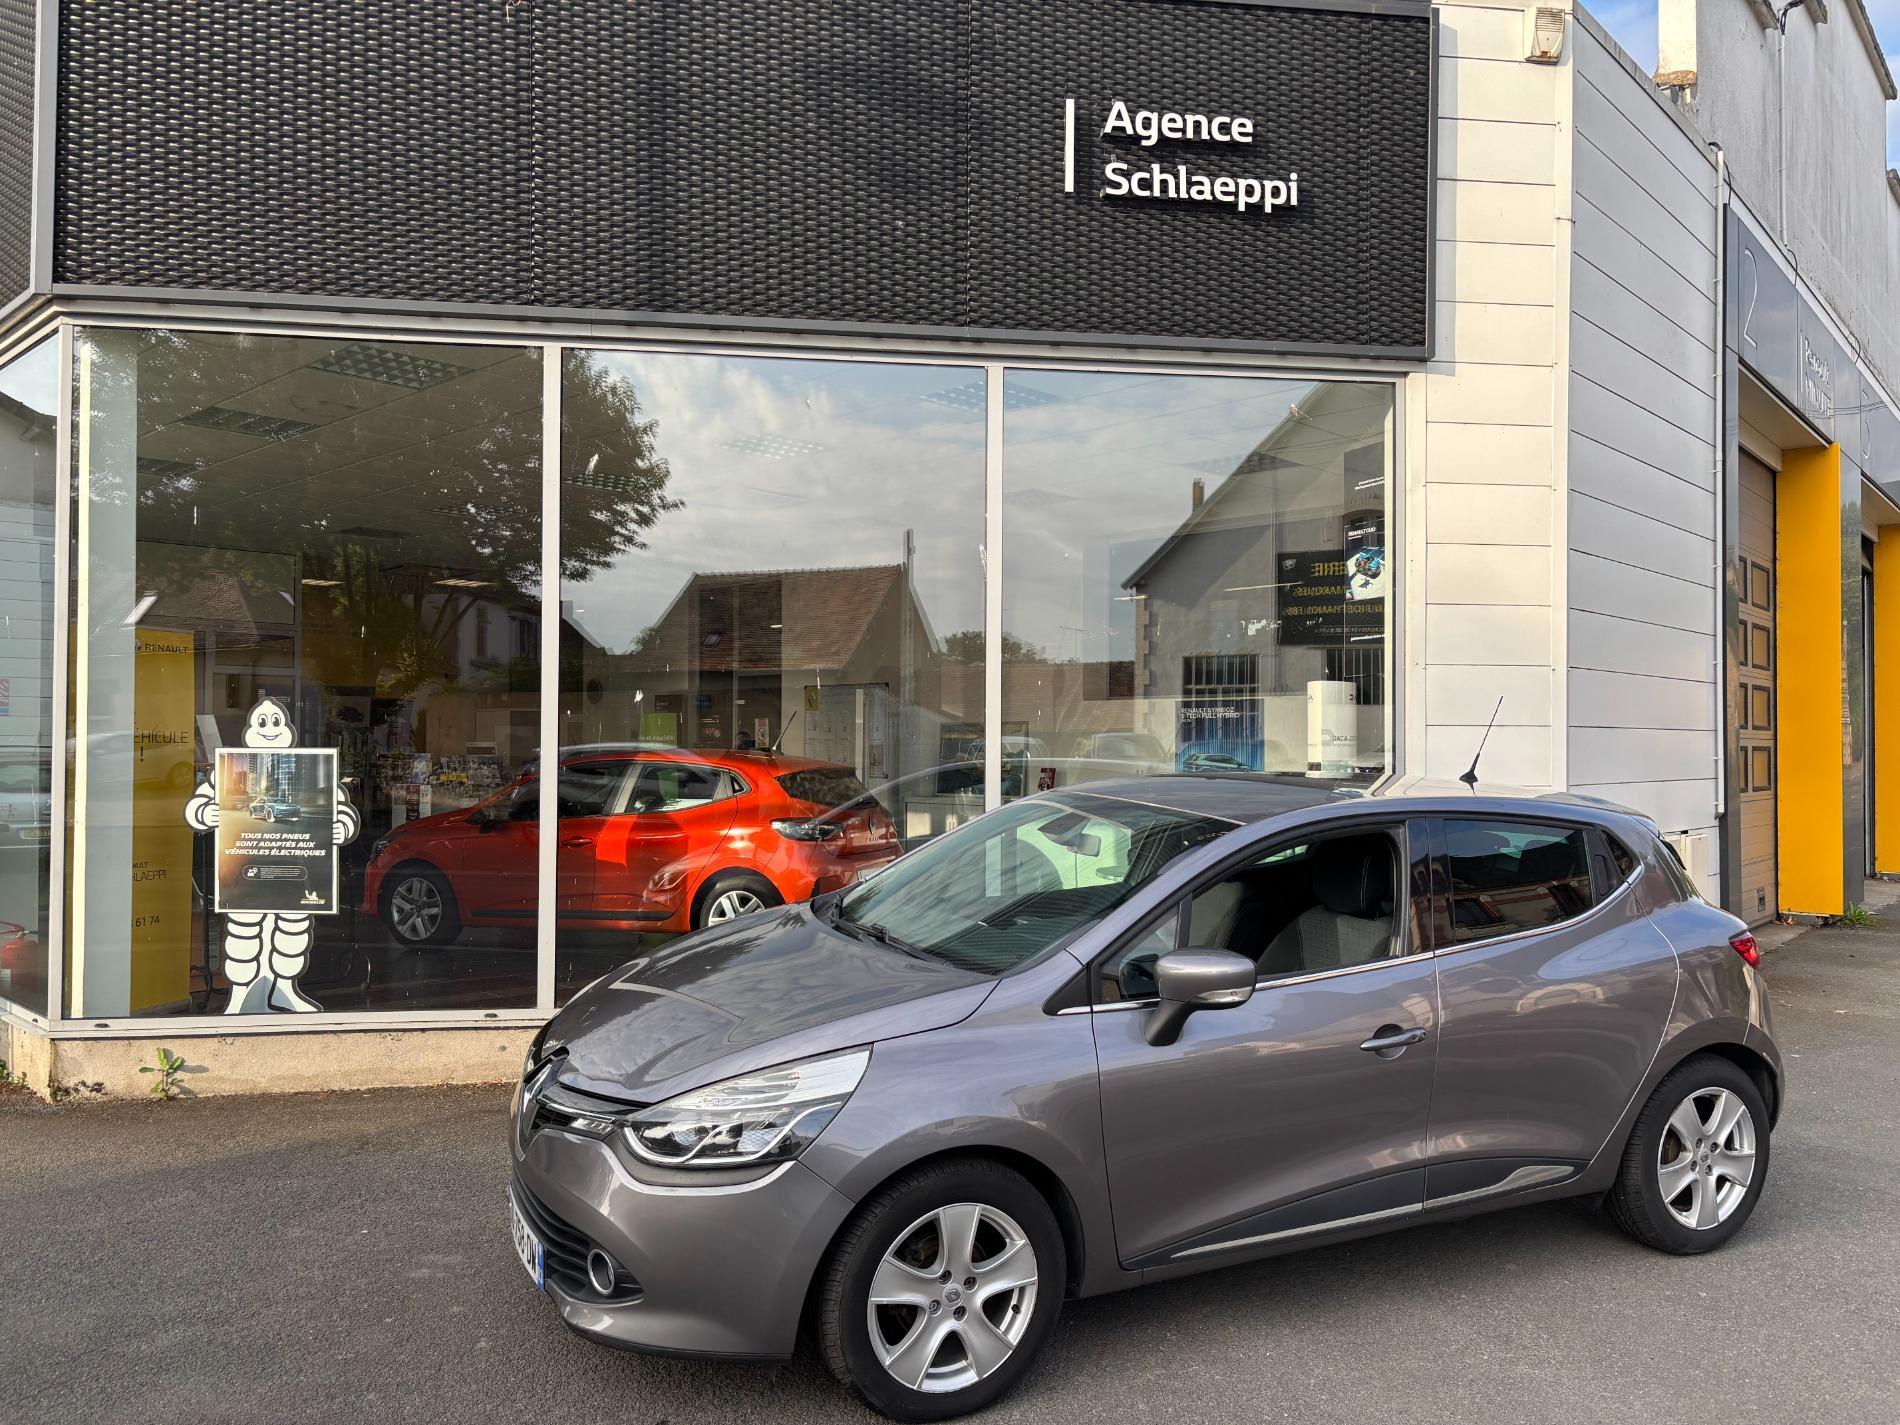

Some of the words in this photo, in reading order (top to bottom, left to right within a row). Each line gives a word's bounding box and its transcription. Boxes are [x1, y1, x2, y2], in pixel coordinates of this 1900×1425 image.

[1103, 101, 1254, 146] Agence
[1104, 162, 1298, 213] Schlaeppi
[1744, 247, 1758, 349] 2
[145, 643, 188, 653] RENAULT
[225, 848, 270, 856] VÉHICULES
[270, 848, 327, 857] ÉLECTRIQUES
[258, 840, 296, 848] ADAPTÉS
